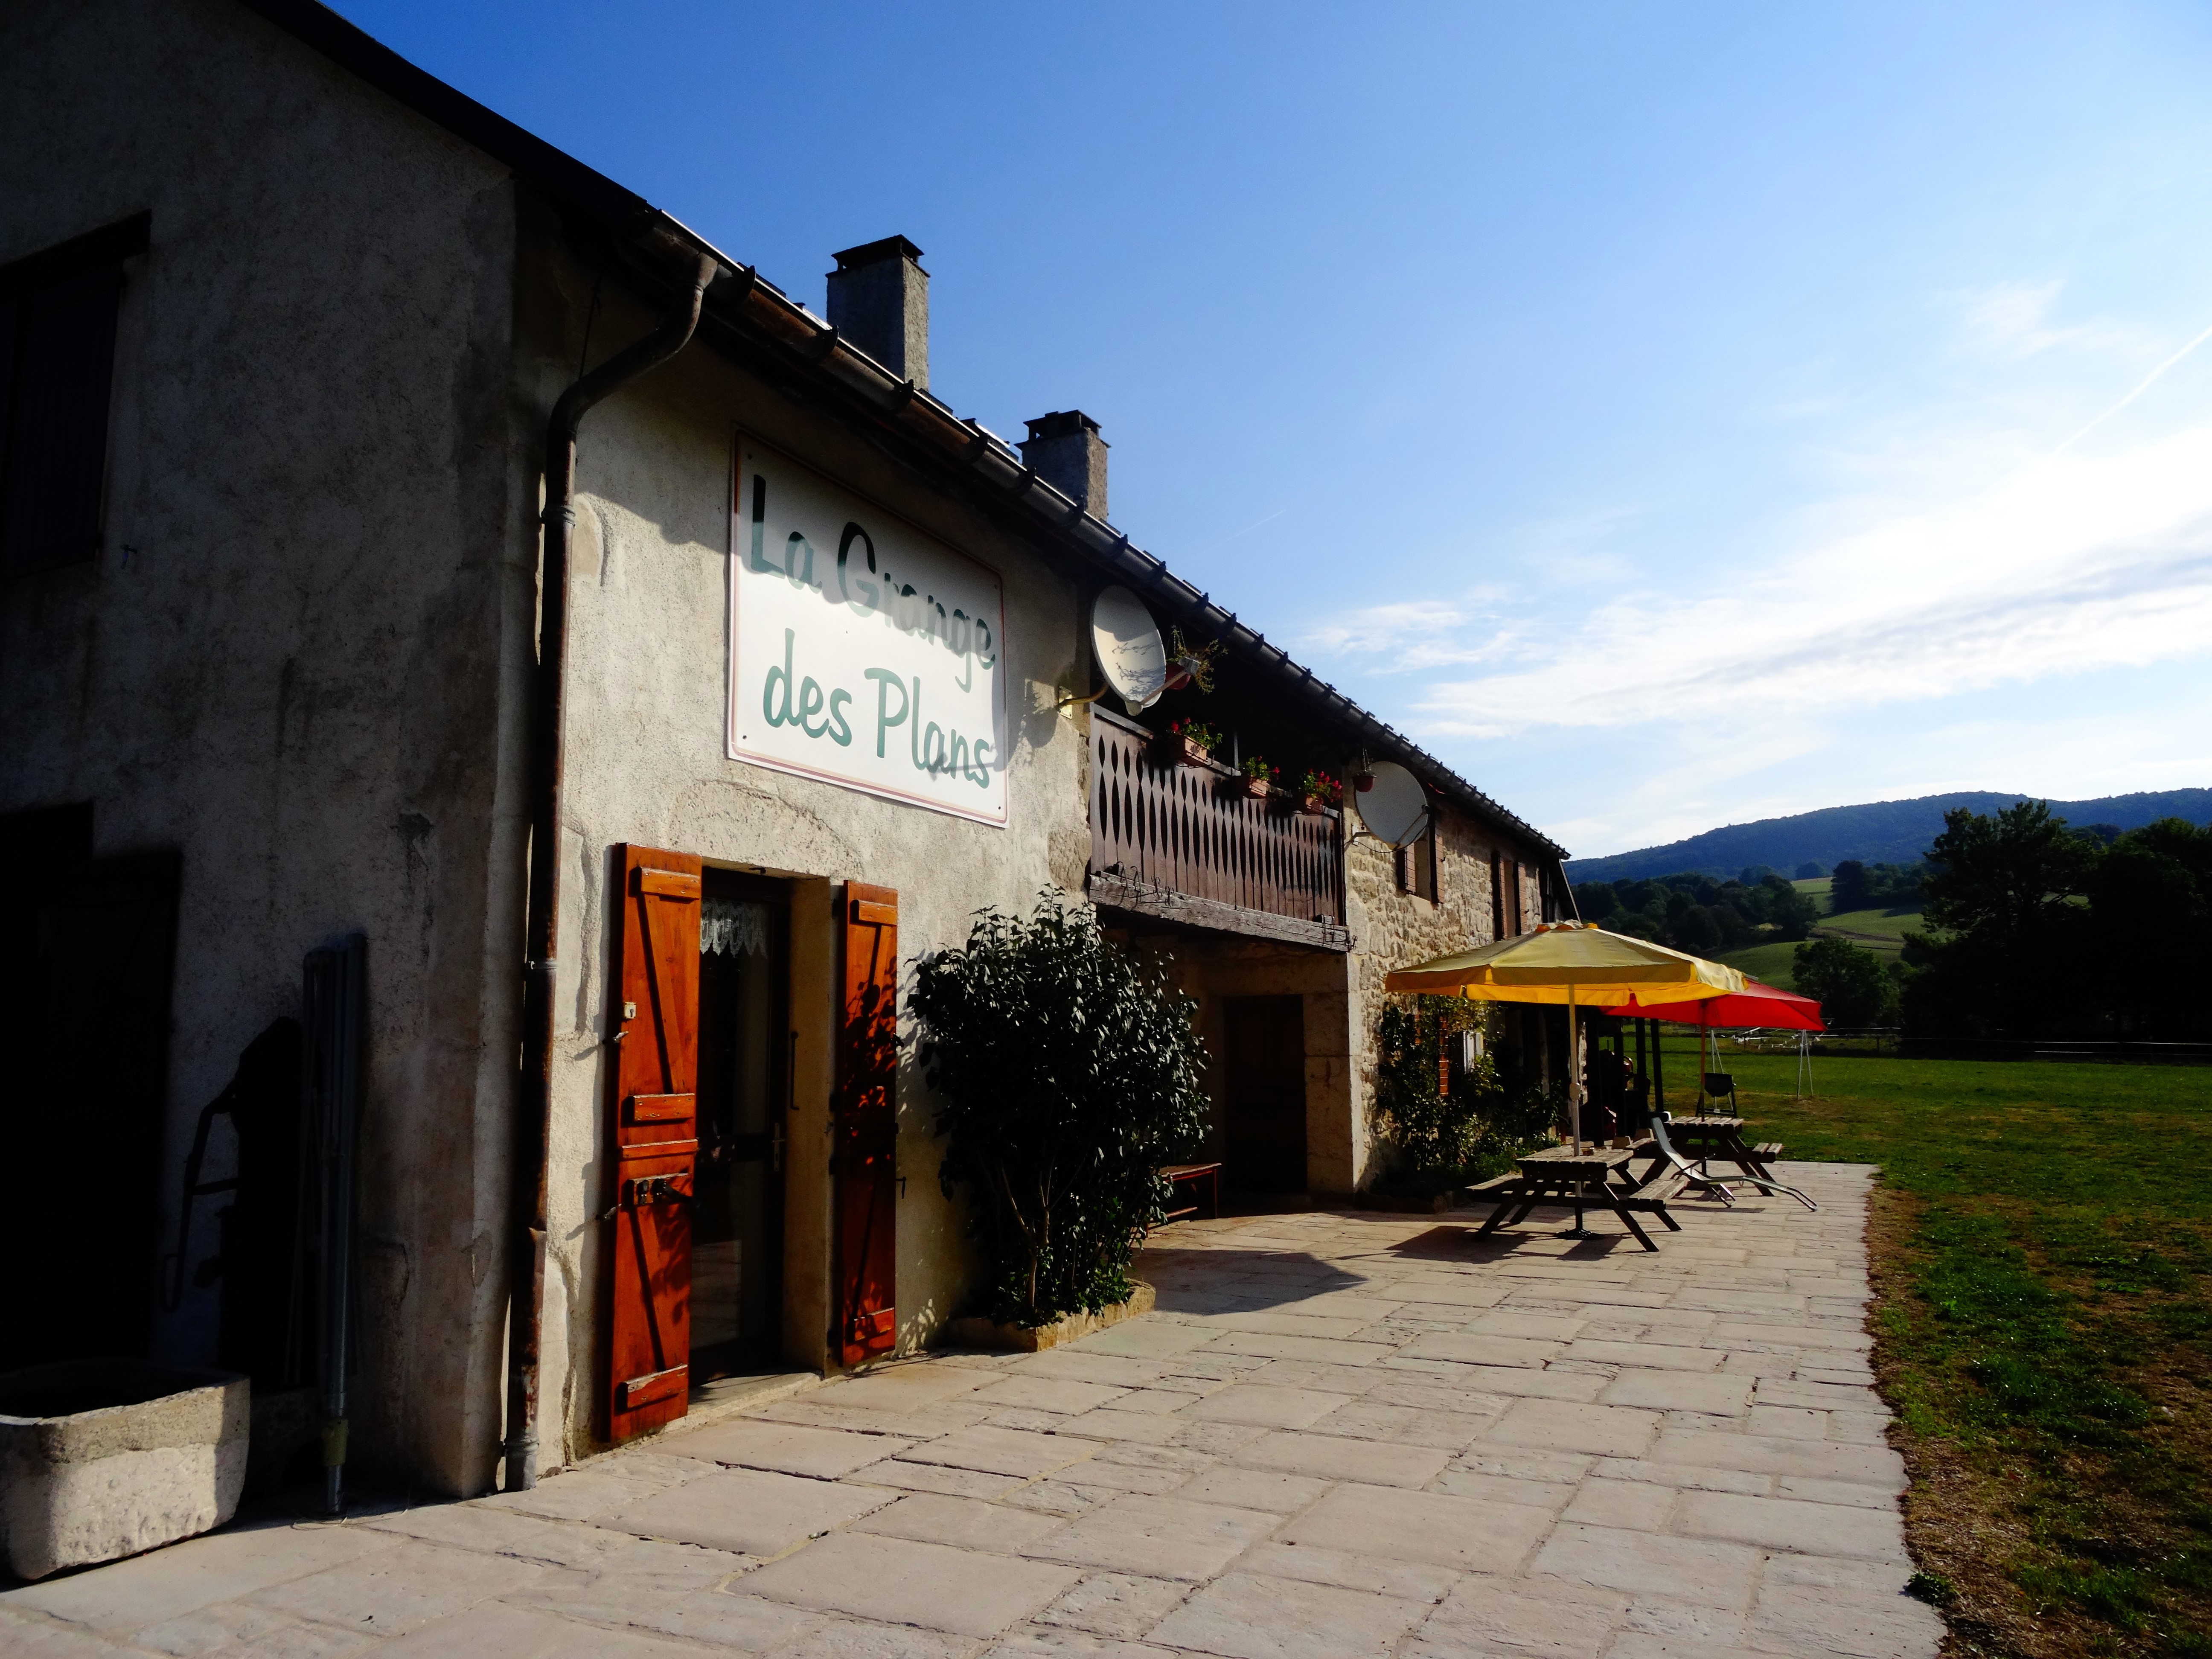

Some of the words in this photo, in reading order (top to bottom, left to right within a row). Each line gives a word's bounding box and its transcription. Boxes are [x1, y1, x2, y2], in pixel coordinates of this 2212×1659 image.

[751, 474, 823, 594] La
[837, 521, 996, 693] Grange
[763, 627, 853, 747] des
[864, 667, 991, 789] Plans
